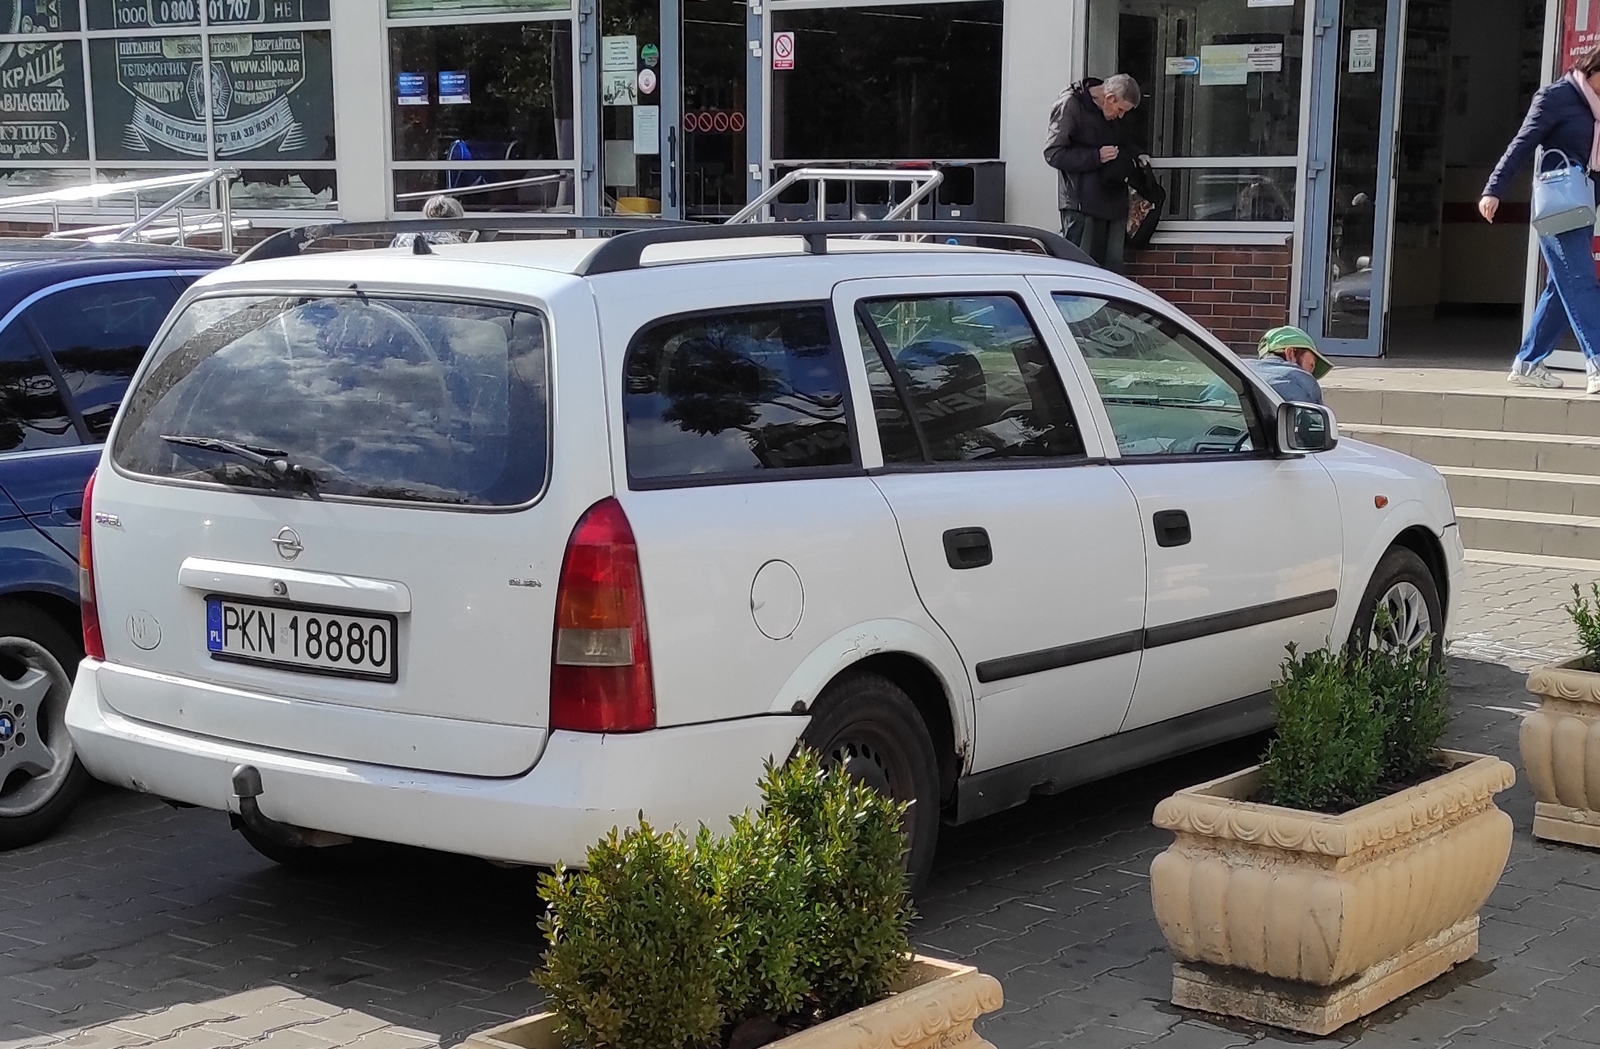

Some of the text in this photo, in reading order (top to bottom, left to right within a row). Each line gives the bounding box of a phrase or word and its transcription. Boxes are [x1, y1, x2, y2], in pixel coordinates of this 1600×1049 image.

[118, 6, 147, 24] 1000
[171, 0, 194, 20] 800
[230, 54, 300, 77] www.silpo.ua
[144, 114, 163, 132] ВАШ
[230, 130, 242, 141] НА
[210, 629, 221, 643] PL
[223, 605, 387, 668] PKN 18880
